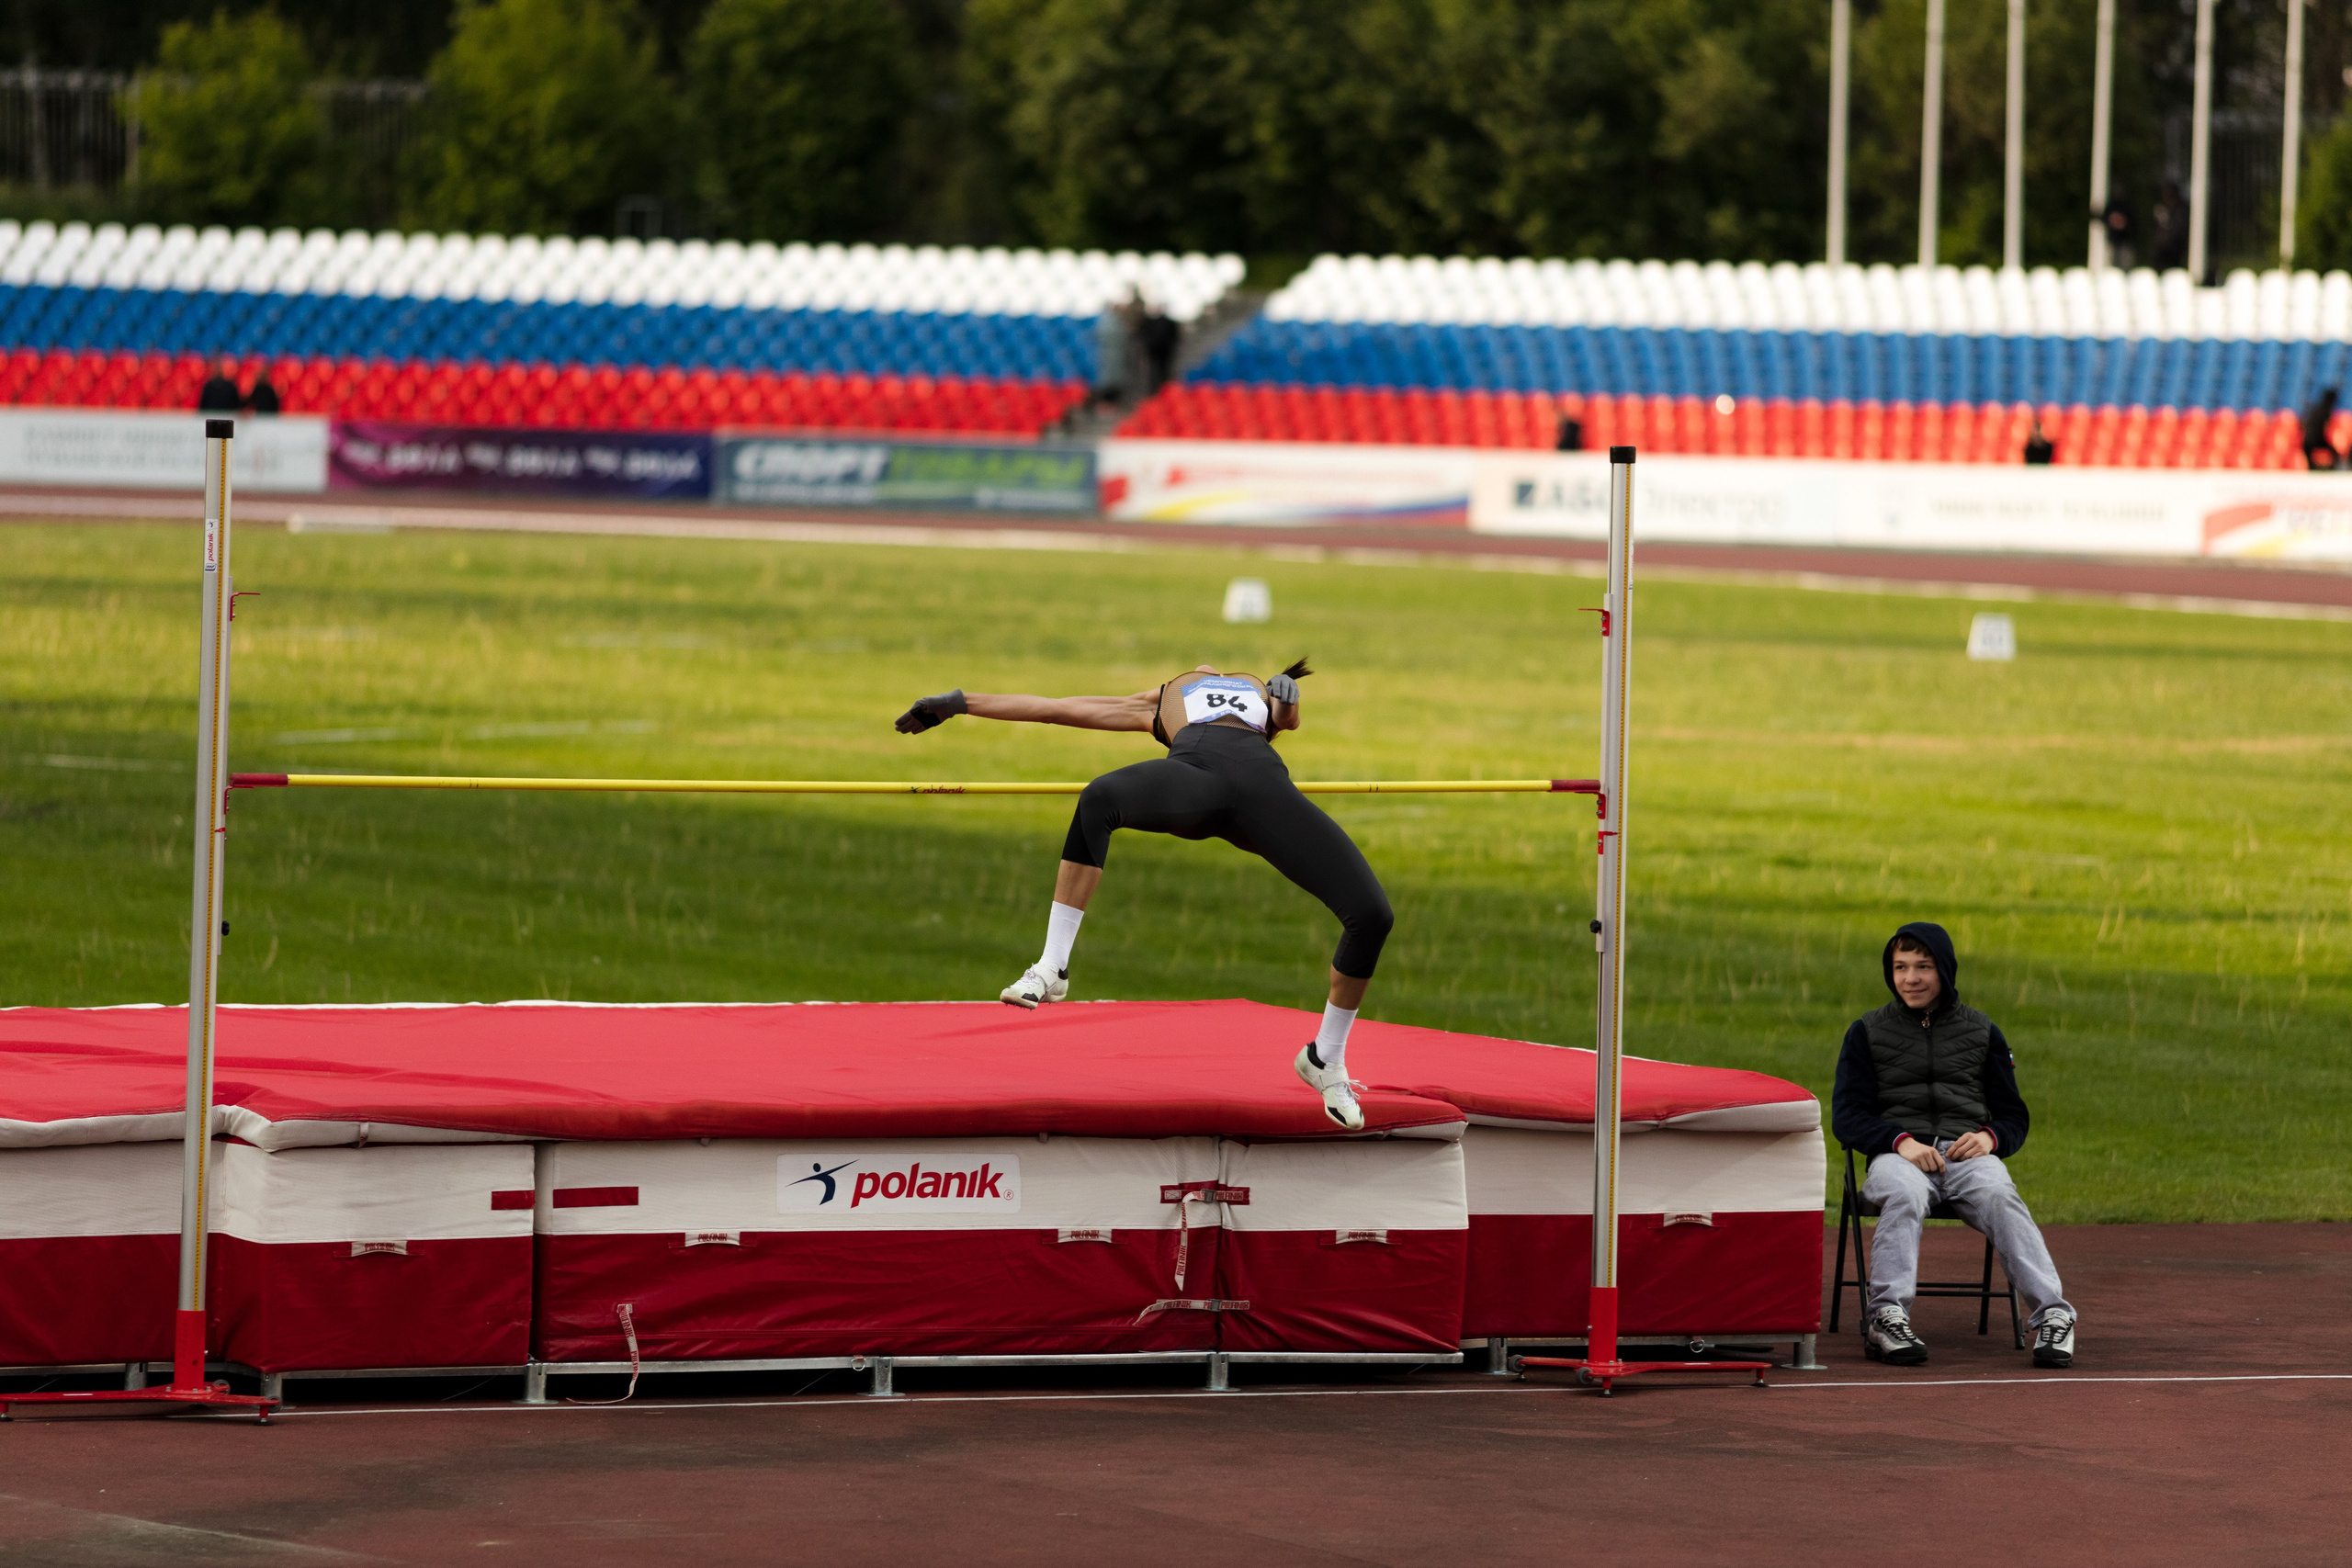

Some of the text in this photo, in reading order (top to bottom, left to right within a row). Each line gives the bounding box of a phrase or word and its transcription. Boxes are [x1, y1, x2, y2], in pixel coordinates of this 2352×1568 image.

[207, 532, 215, 562] polanik
[1206, 694, 1248, 713] 84
[850, 1162, 1004, 1209] polanik
[698, 1232, 728, 1242] POLANIK
[1070, 1229, 1100, 1239] POLANIK
[1176, 1245, 1187, 1277] POLANIK
